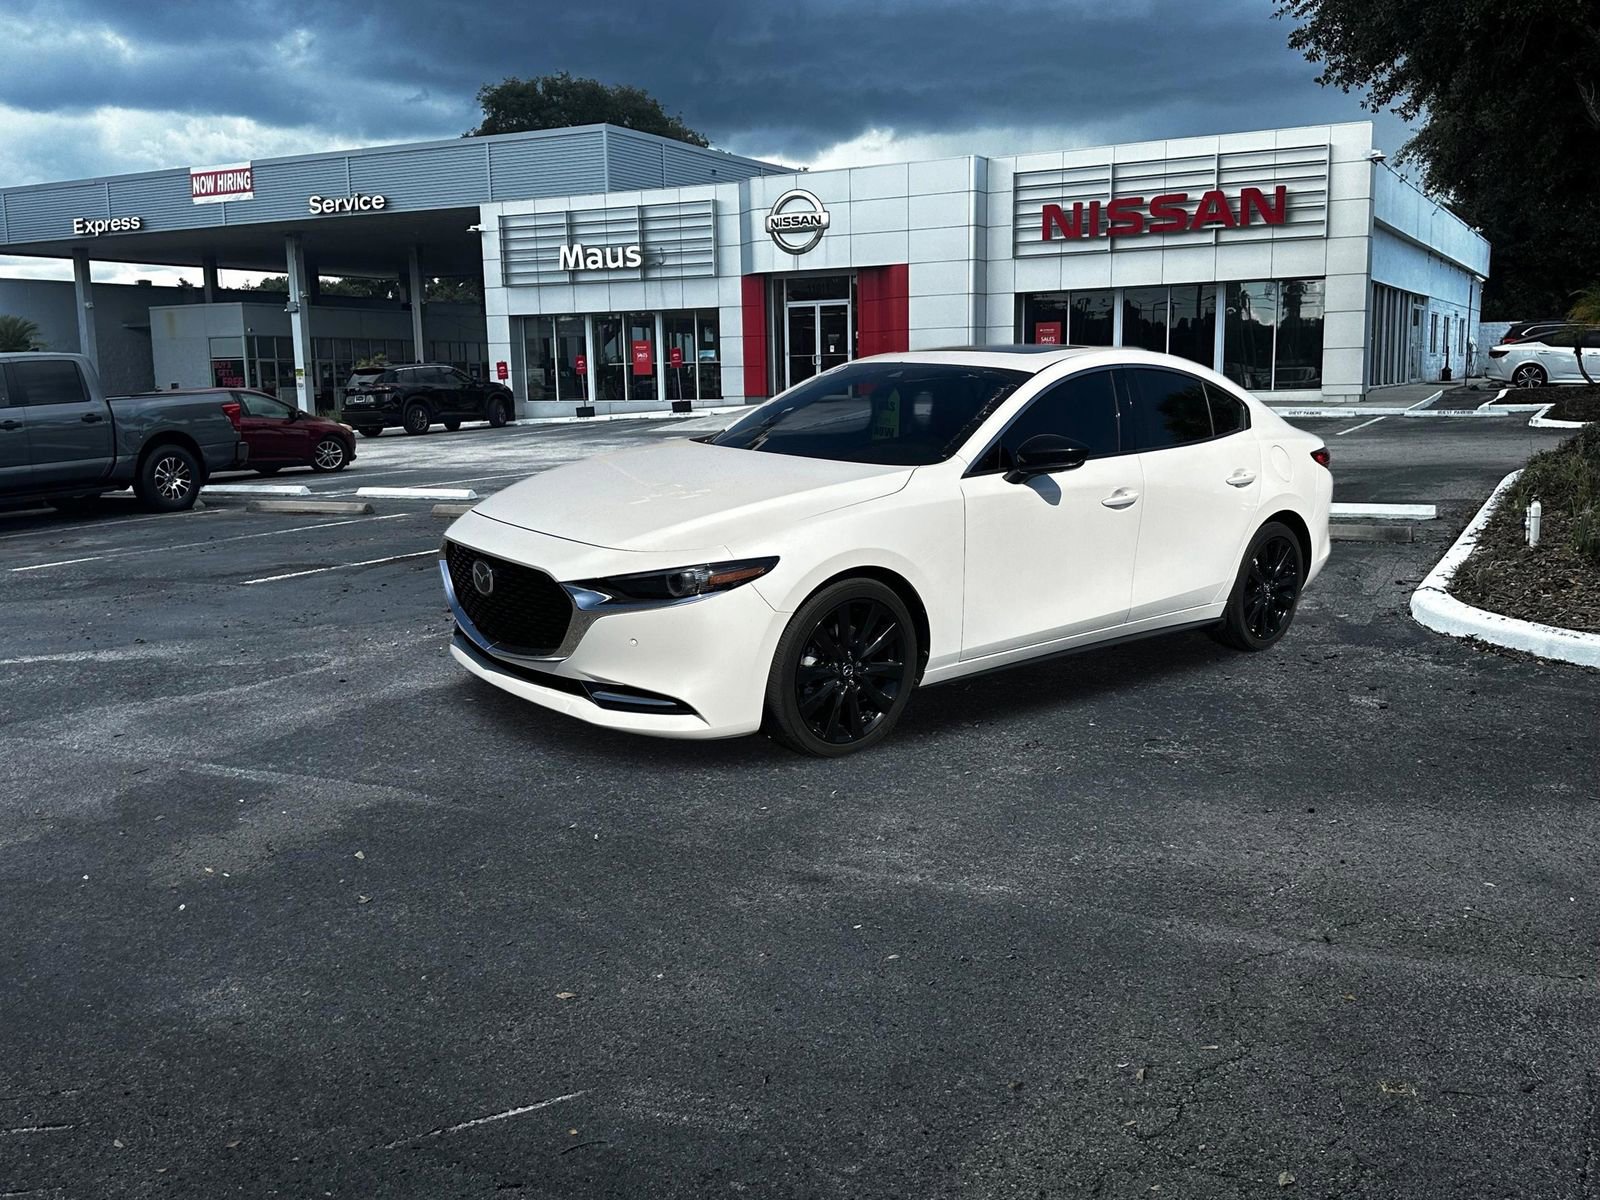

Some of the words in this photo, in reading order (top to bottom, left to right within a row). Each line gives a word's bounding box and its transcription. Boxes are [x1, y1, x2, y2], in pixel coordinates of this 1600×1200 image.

[192, 175, 215, 195] NOW
[217, 171, 251, 192] HIRING
[309, 193, 385, 214] Service
[1042, 185, 1287, 241] NISSAN
[72, 216, 141, 236] Express
[770, 214, 822, 229] NISSAN
[558, 244, 642, 271] Maus
